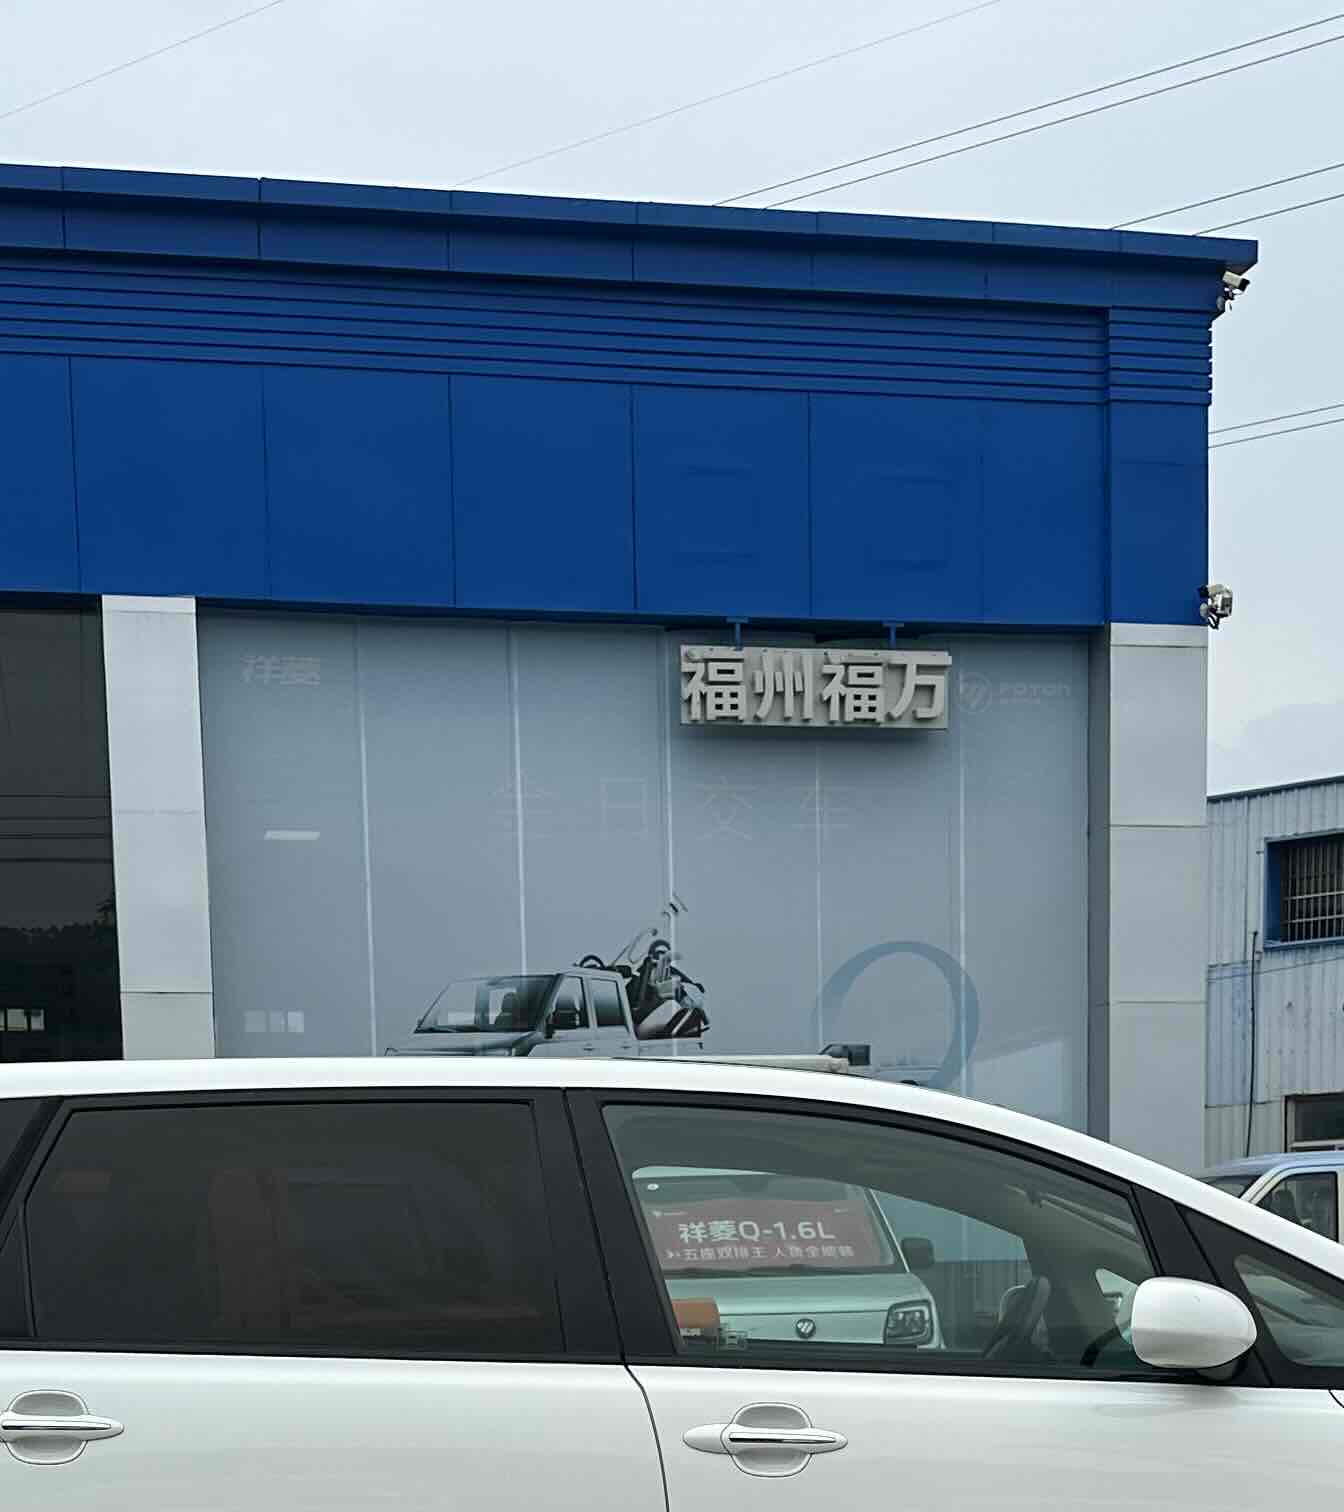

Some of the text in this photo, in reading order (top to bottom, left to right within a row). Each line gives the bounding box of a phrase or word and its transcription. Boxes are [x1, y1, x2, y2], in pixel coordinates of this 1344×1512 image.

[683, 654, 948, 723] 福州福万
[677, 1219, 837, 1244] 祥菱Q-1.6L
